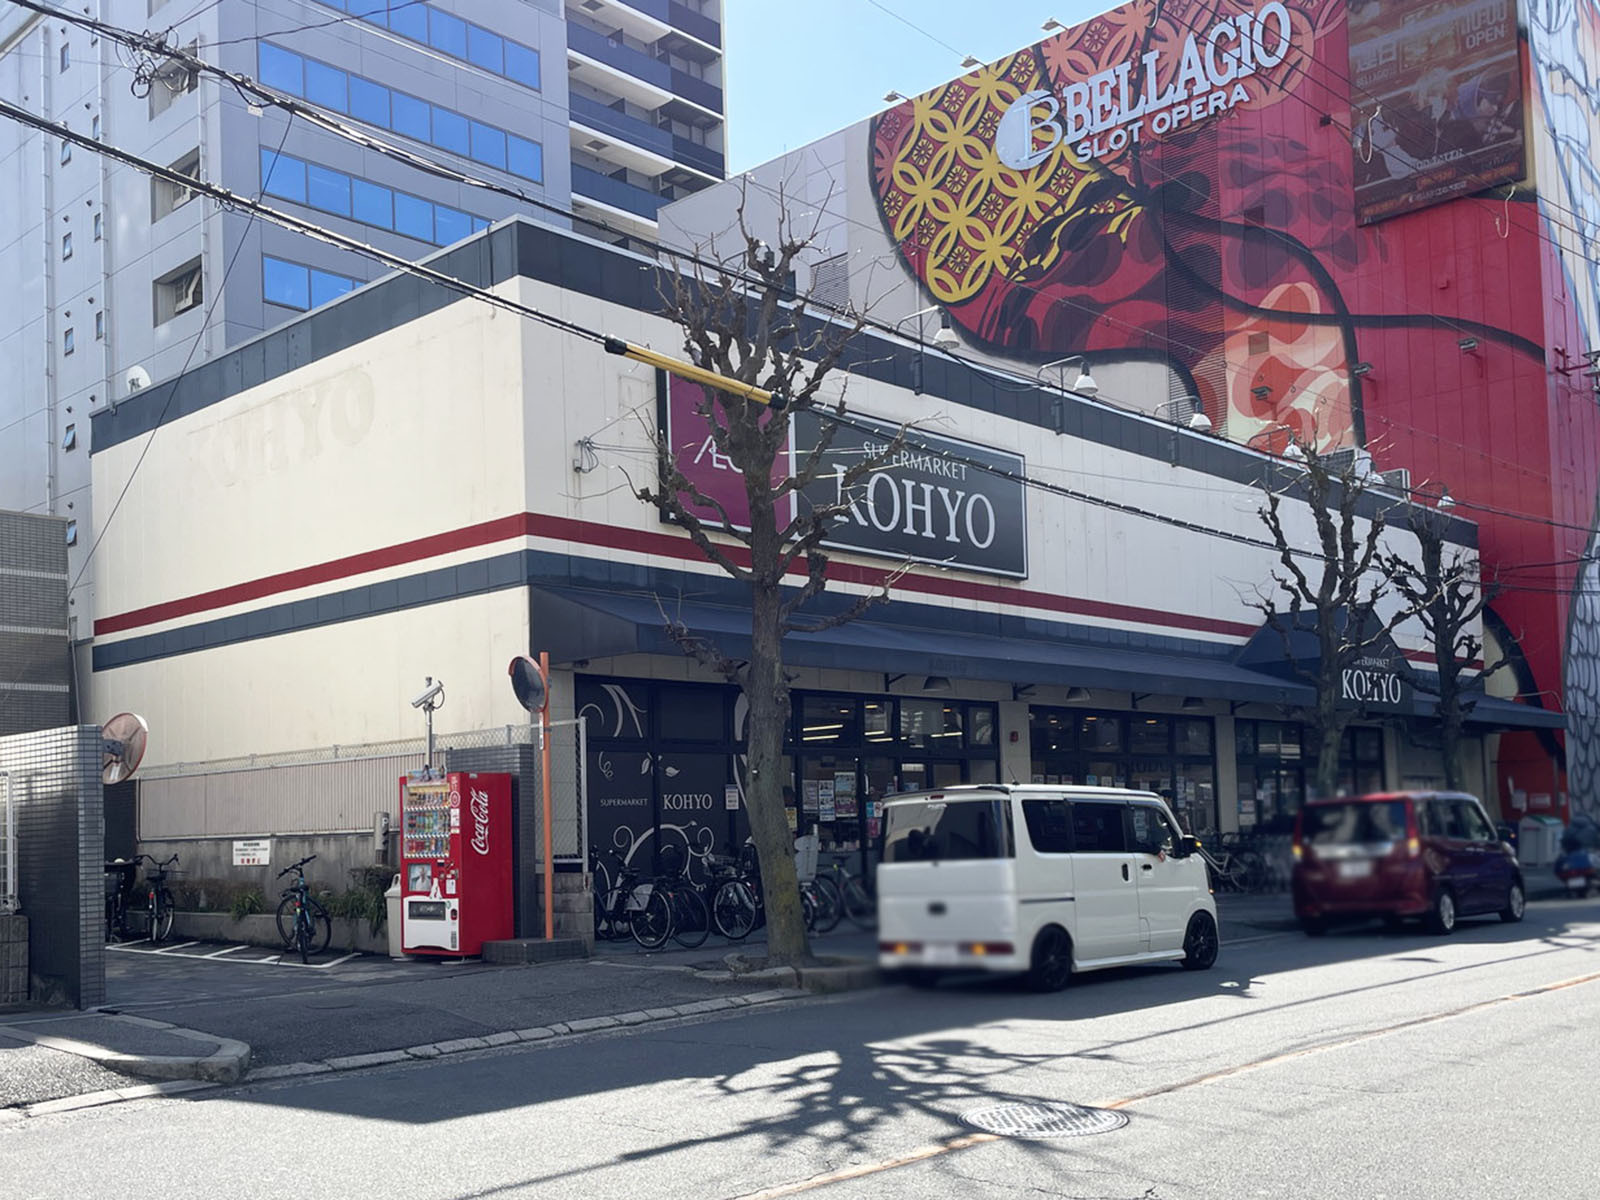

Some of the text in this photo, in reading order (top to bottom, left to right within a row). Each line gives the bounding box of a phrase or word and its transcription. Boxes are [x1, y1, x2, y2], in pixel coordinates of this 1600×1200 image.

[1063, 1, 1291, 144] BELLAGIO
[1466, 23, 1505, 49] OPEN
[1076, 84, 1250, 163] SLOT OPERA
[831, 464, 996, 549] KOHYO
[600, 798, 649, 807] SUPERMARKET
[663, 793, 712, 810] KOHYO
